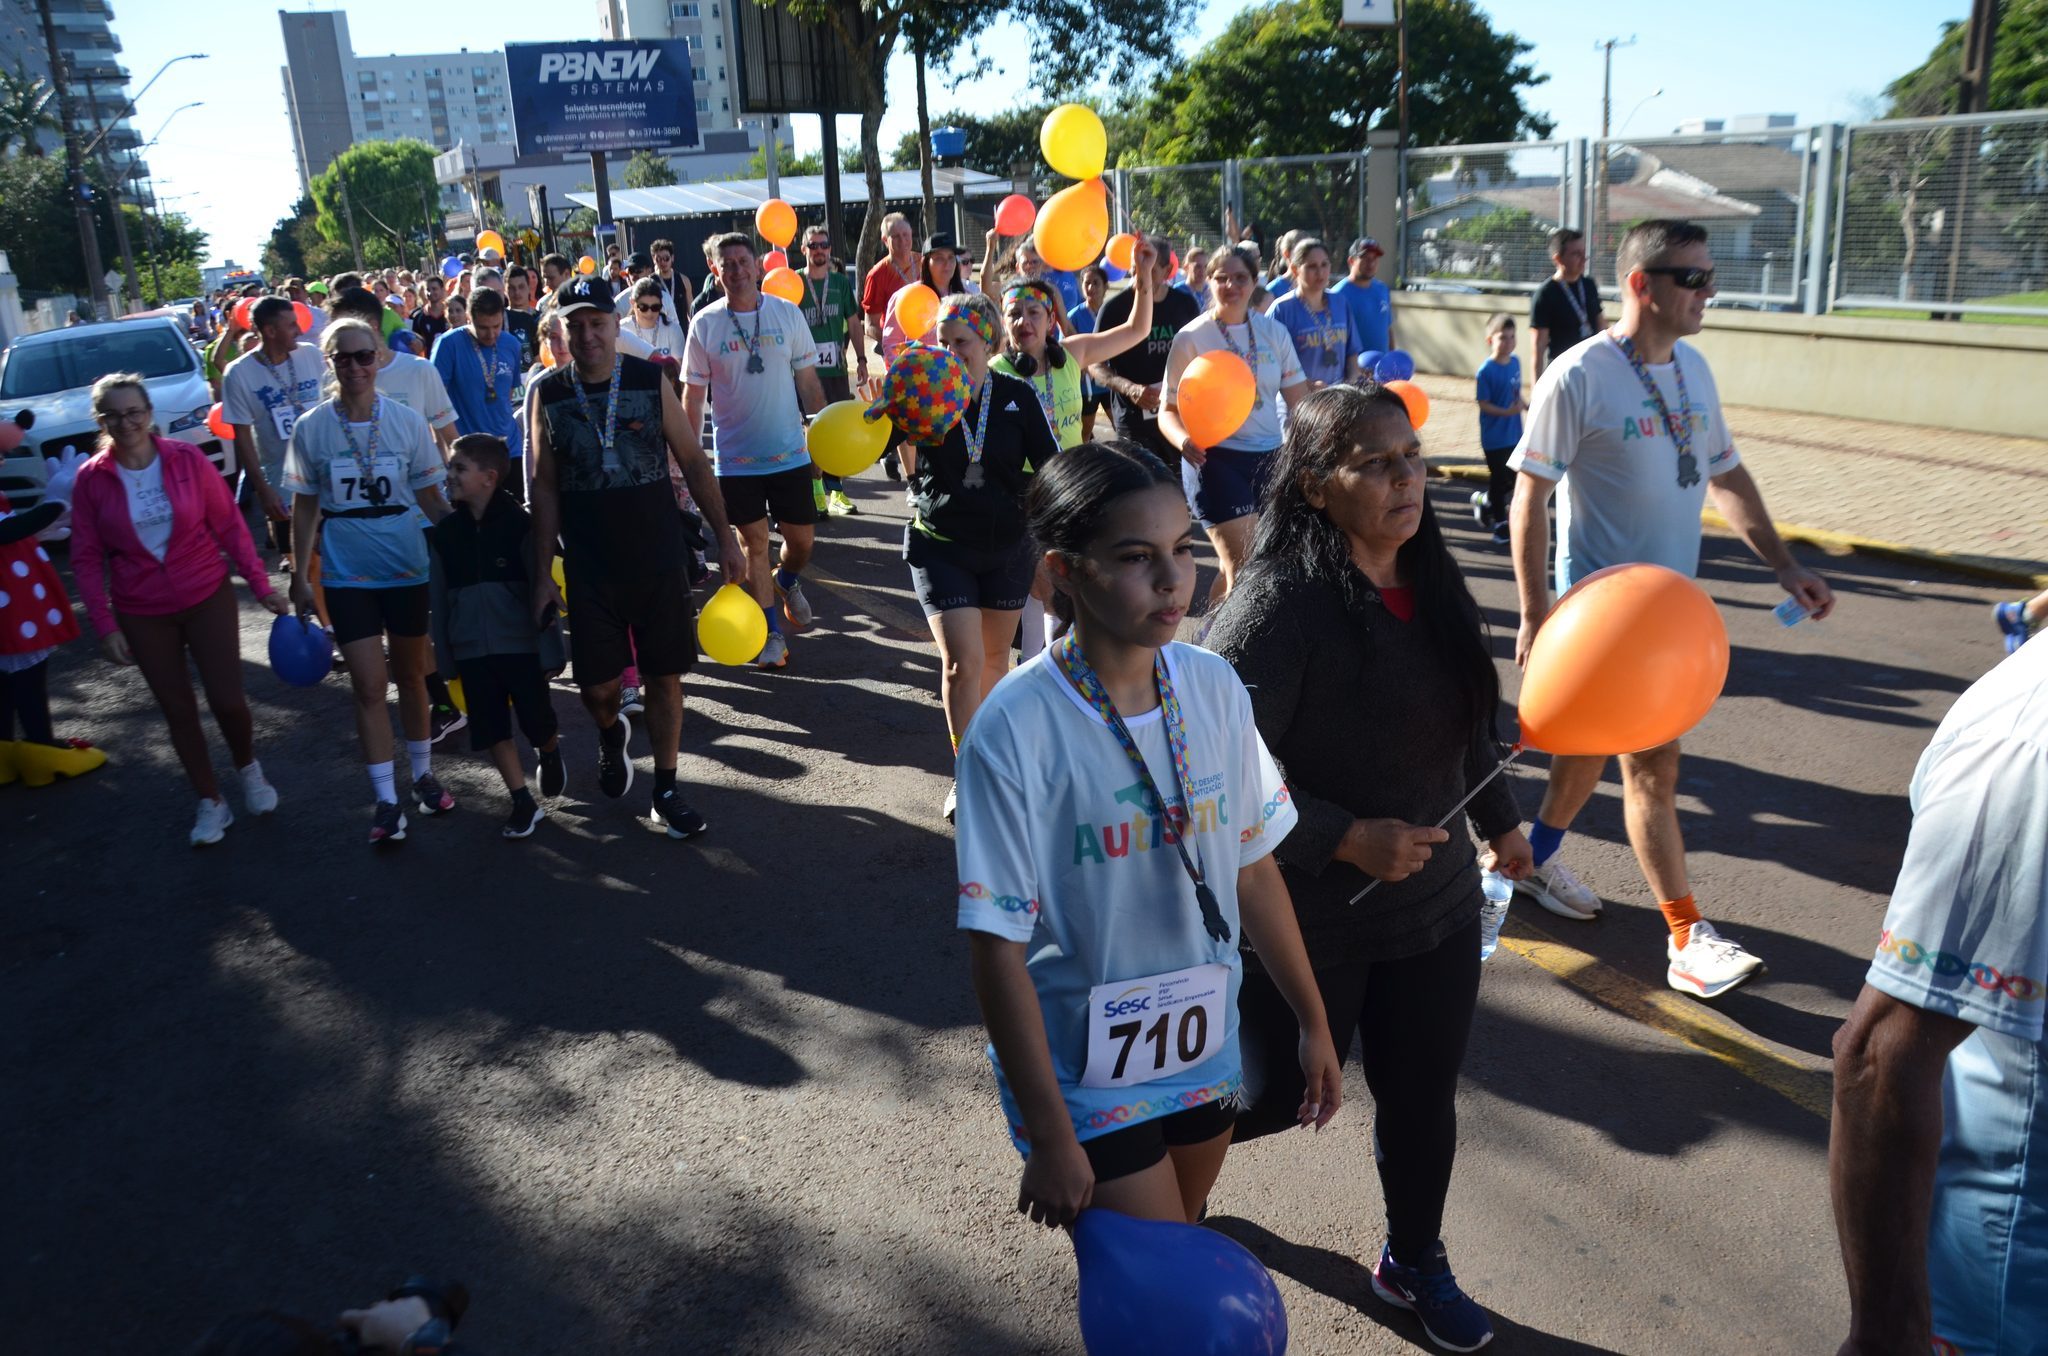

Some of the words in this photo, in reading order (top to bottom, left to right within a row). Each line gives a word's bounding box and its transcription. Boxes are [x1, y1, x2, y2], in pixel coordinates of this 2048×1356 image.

[539, 49, 661, 84] PBNEW
[570, 80, 665, 96] SISTEMAS
[564, 104, 597, 114] Soluções
[599, 101, 646, 112] tecnológicas
[578, 111, 610, 122] produtos
[940, 596, 968, 607] RUN
[1109, 1004, 1207, 1080] 710
